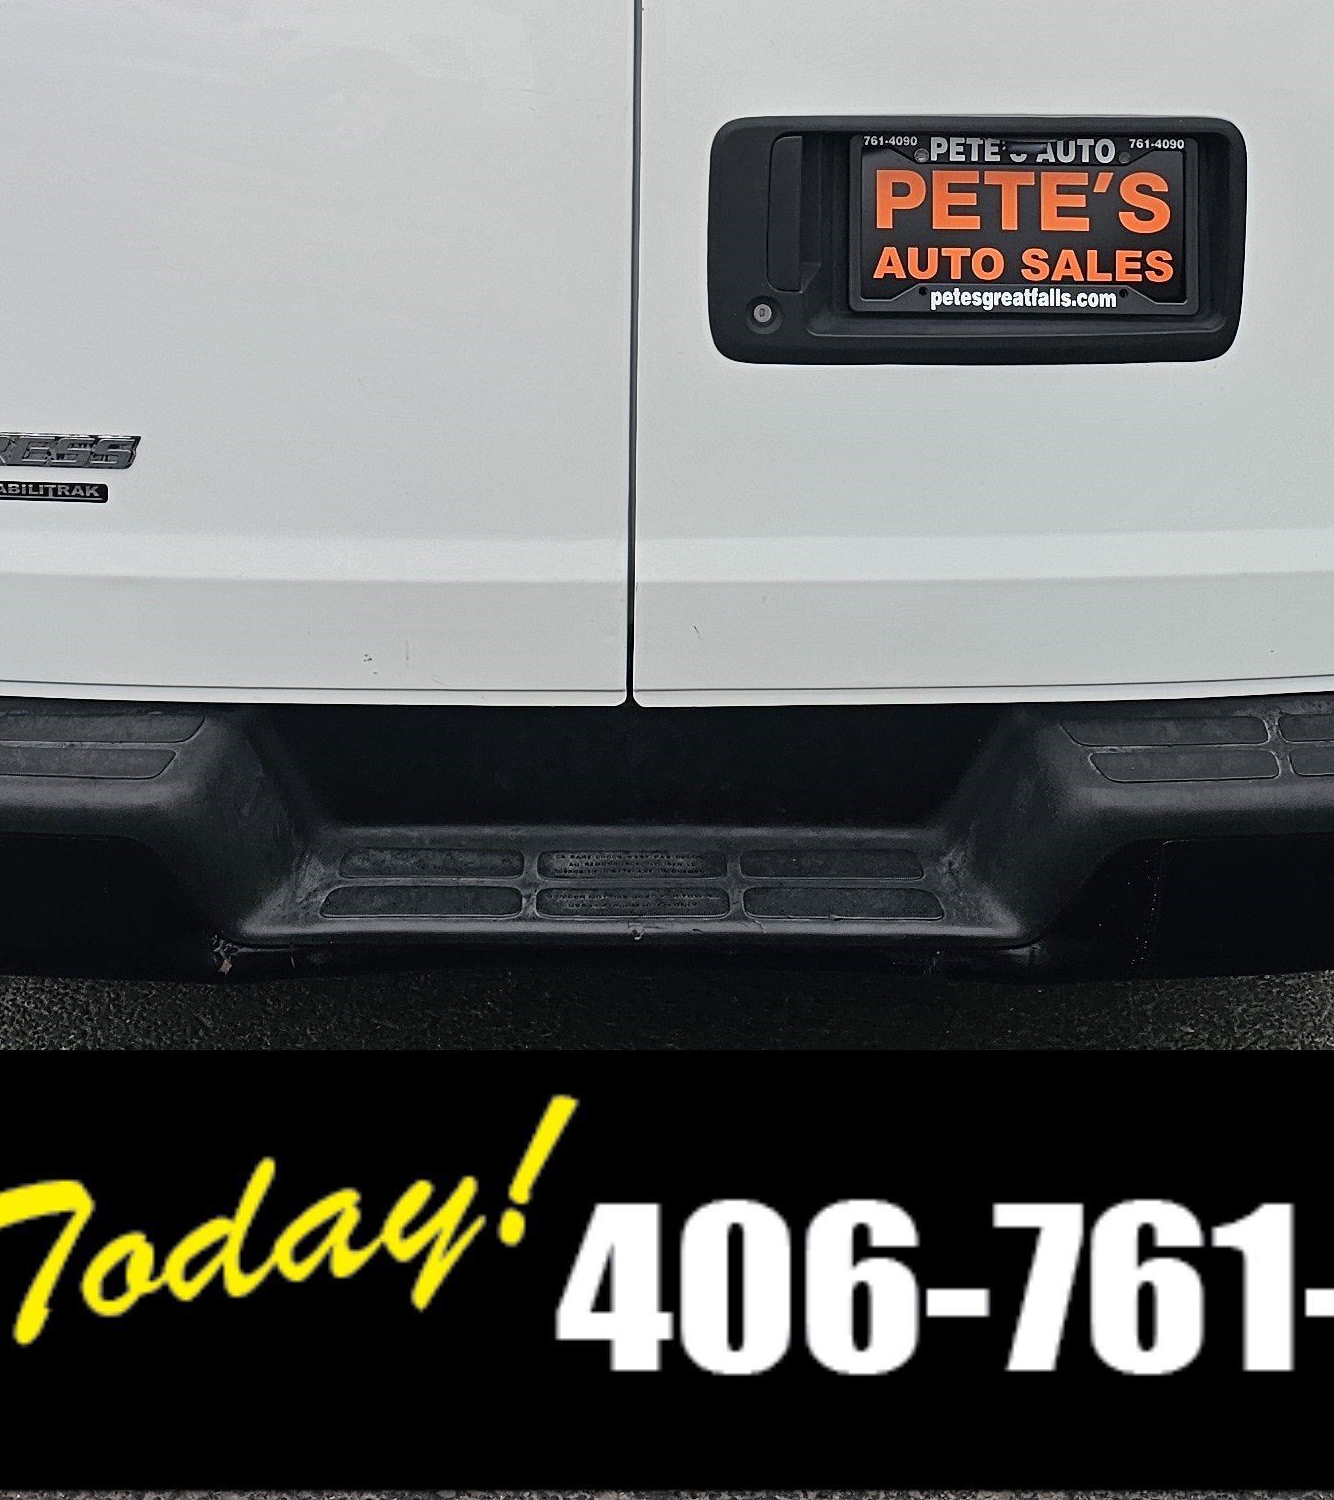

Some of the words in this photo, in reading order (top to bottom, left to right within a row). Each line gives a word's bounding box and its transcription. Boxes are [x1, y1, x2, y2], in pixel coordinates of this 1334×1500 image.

[863, 136, 917, 146] 761-4090
[1128, 138, 1185, 150] 761-4090
[874, 168, 1172, 235] PETE'S
[872, 246, 1006, 281] AUTO
[1020, 248, 1175, 283] SALES
[930, 287, 1118, 311] petesgreatfalls.com
